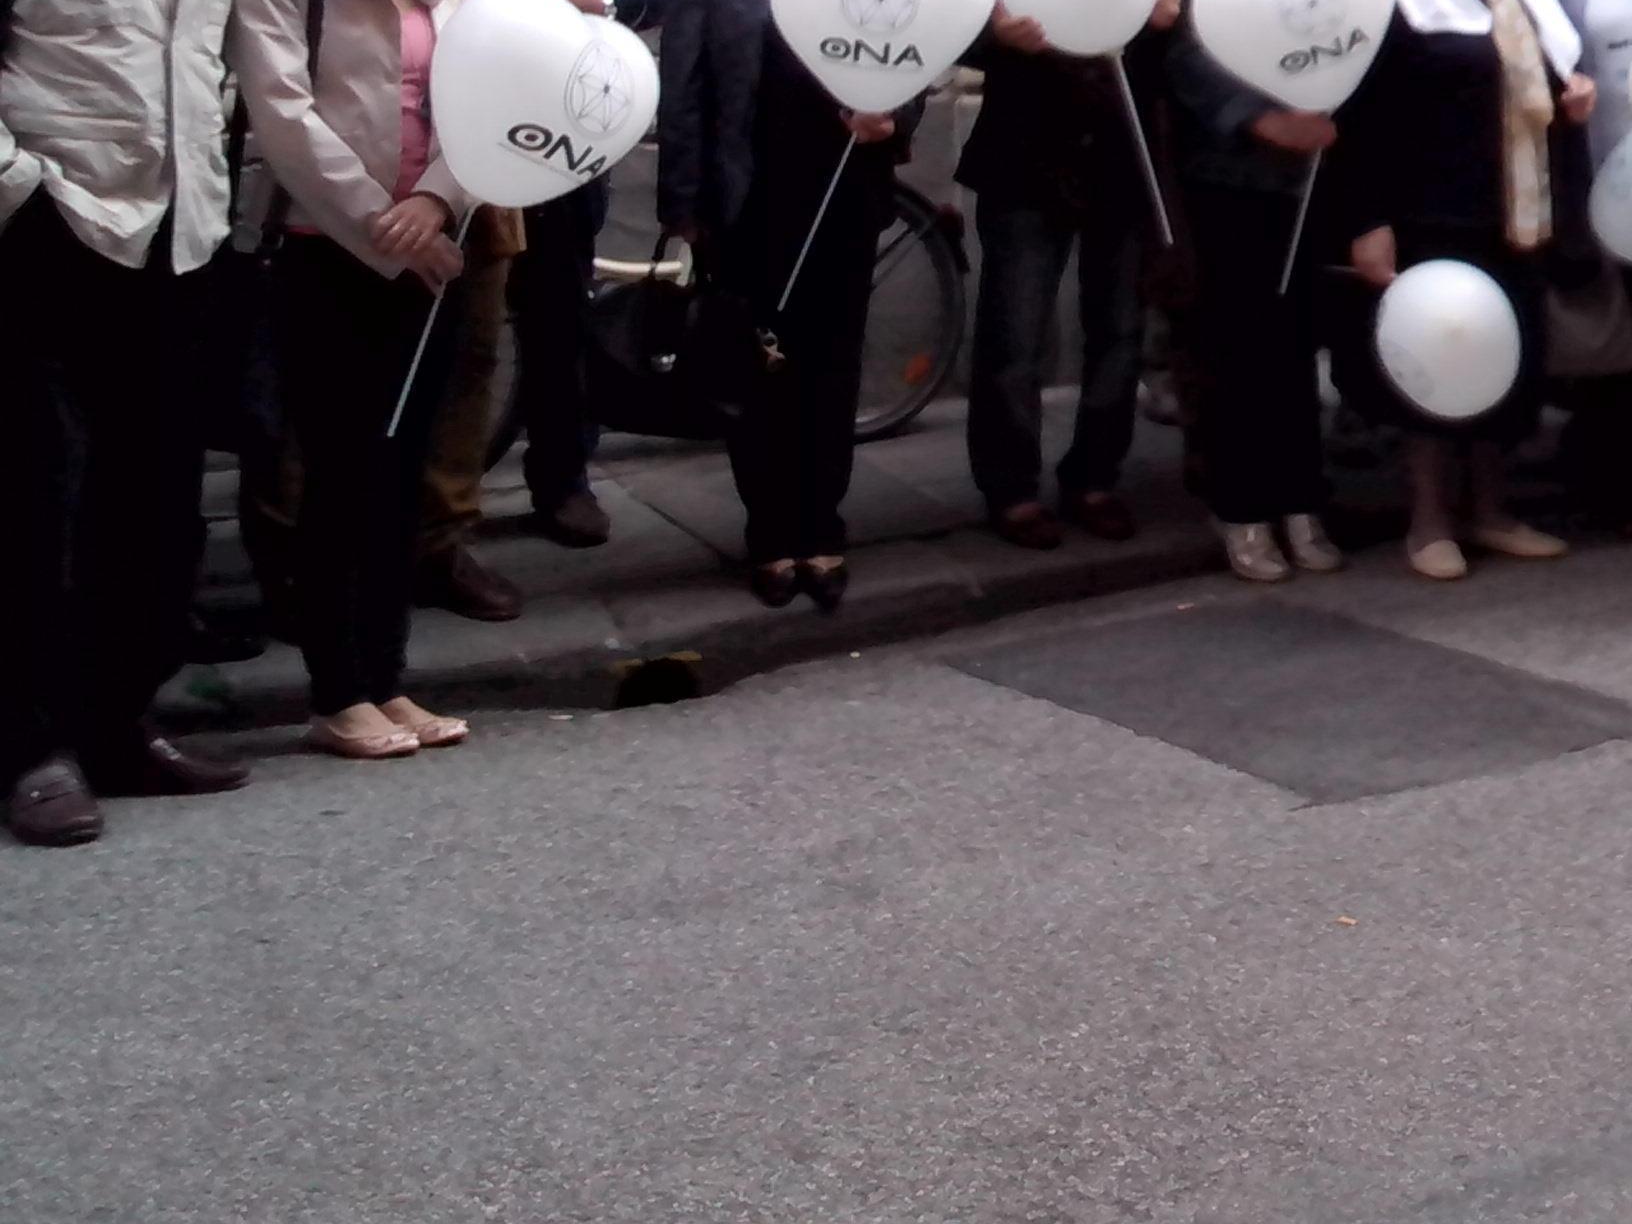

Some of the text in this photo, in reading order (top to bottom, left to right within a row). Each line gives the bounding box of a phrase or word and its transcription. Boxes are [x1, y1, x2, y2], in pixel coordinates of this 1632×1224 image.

[819, 37, 925, 67] ONA
[1279, 27, 1370, 75] ONA
[506, 122, 608, 177] ONA
